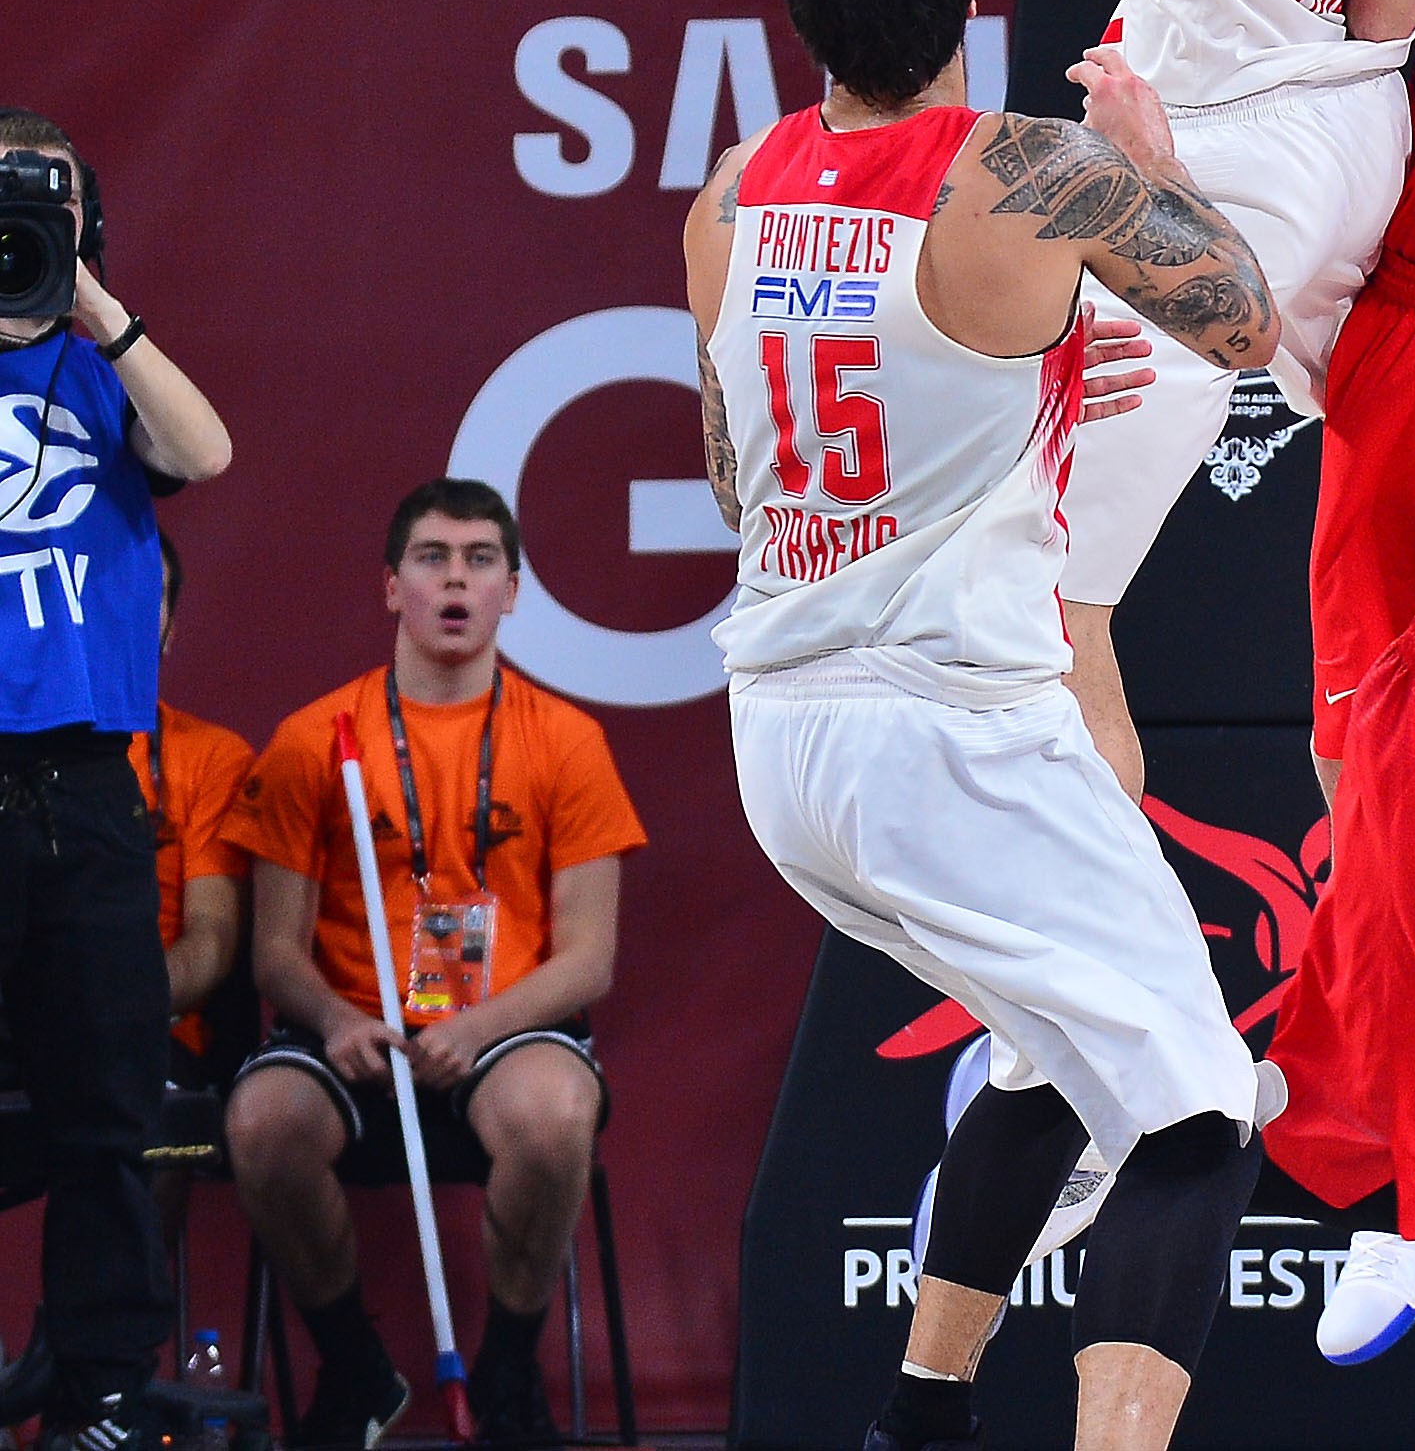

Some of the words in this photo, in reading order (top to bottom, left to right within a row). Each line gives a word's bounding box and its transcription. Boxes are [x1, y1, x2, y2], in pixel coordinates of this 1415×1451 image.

[756, 210, 895, 274] PRINTEZIS
[752, 275, 881, 318] FMS
[759, 331, 892, 506] 15
